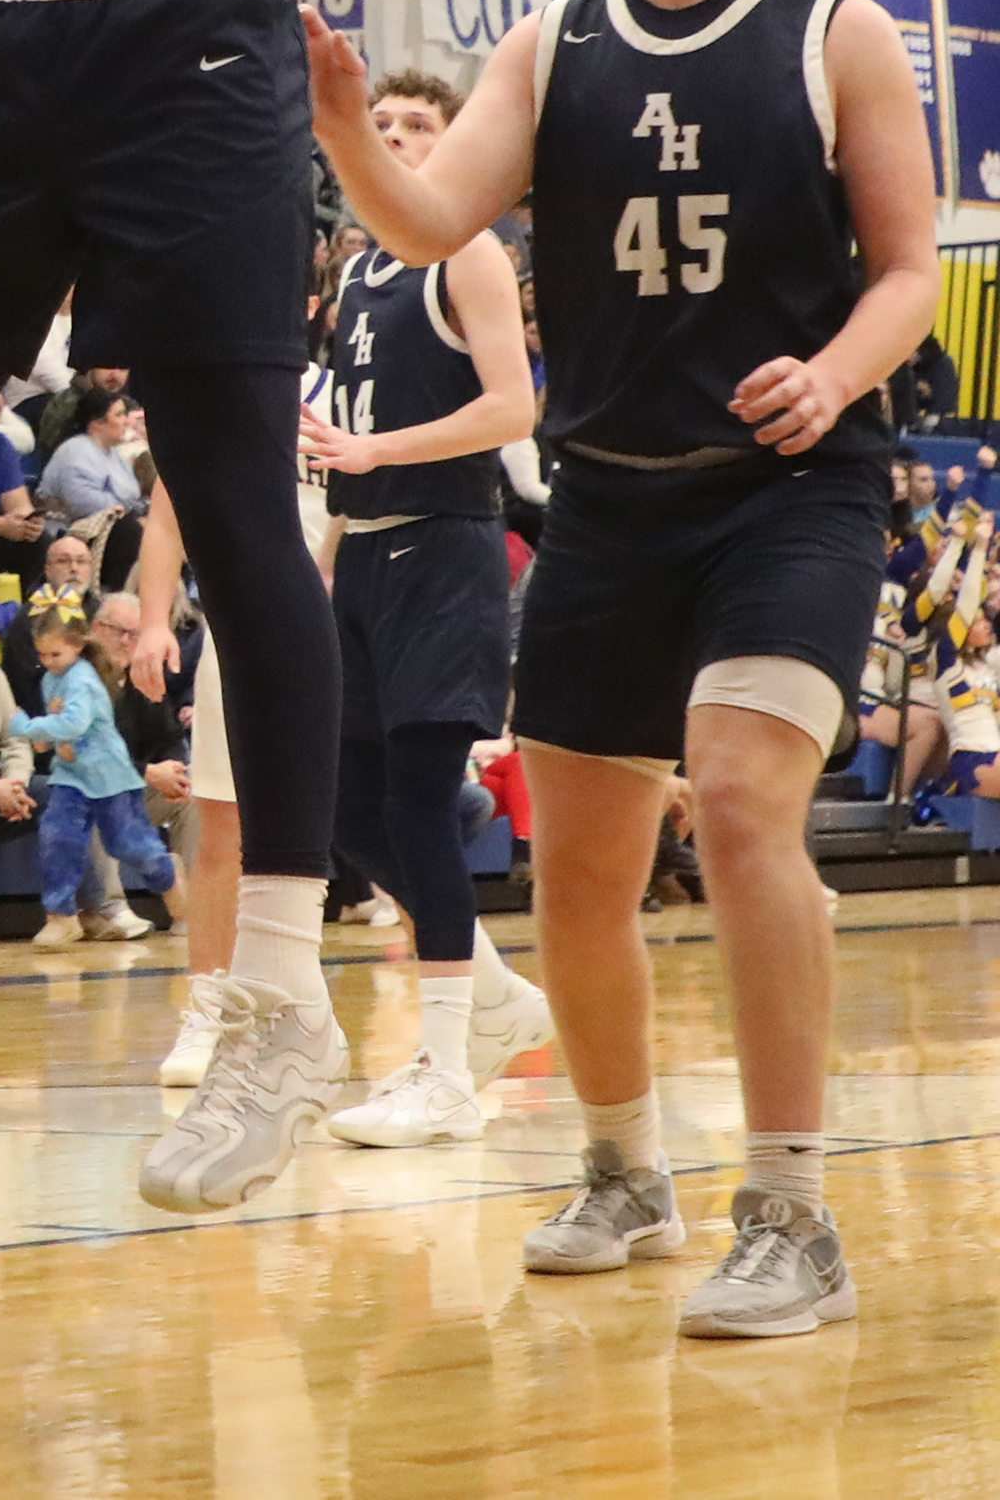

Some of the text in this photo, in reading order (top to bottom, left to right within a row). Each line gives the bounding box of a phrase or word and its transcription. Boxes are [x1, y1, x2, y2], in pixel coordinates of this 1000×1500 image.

[632, 92, 702, 172] AH
[613, 193, 730, 297] 45
[347, 311, 376, 367] AH
[335, 378, 375, 436] 14
